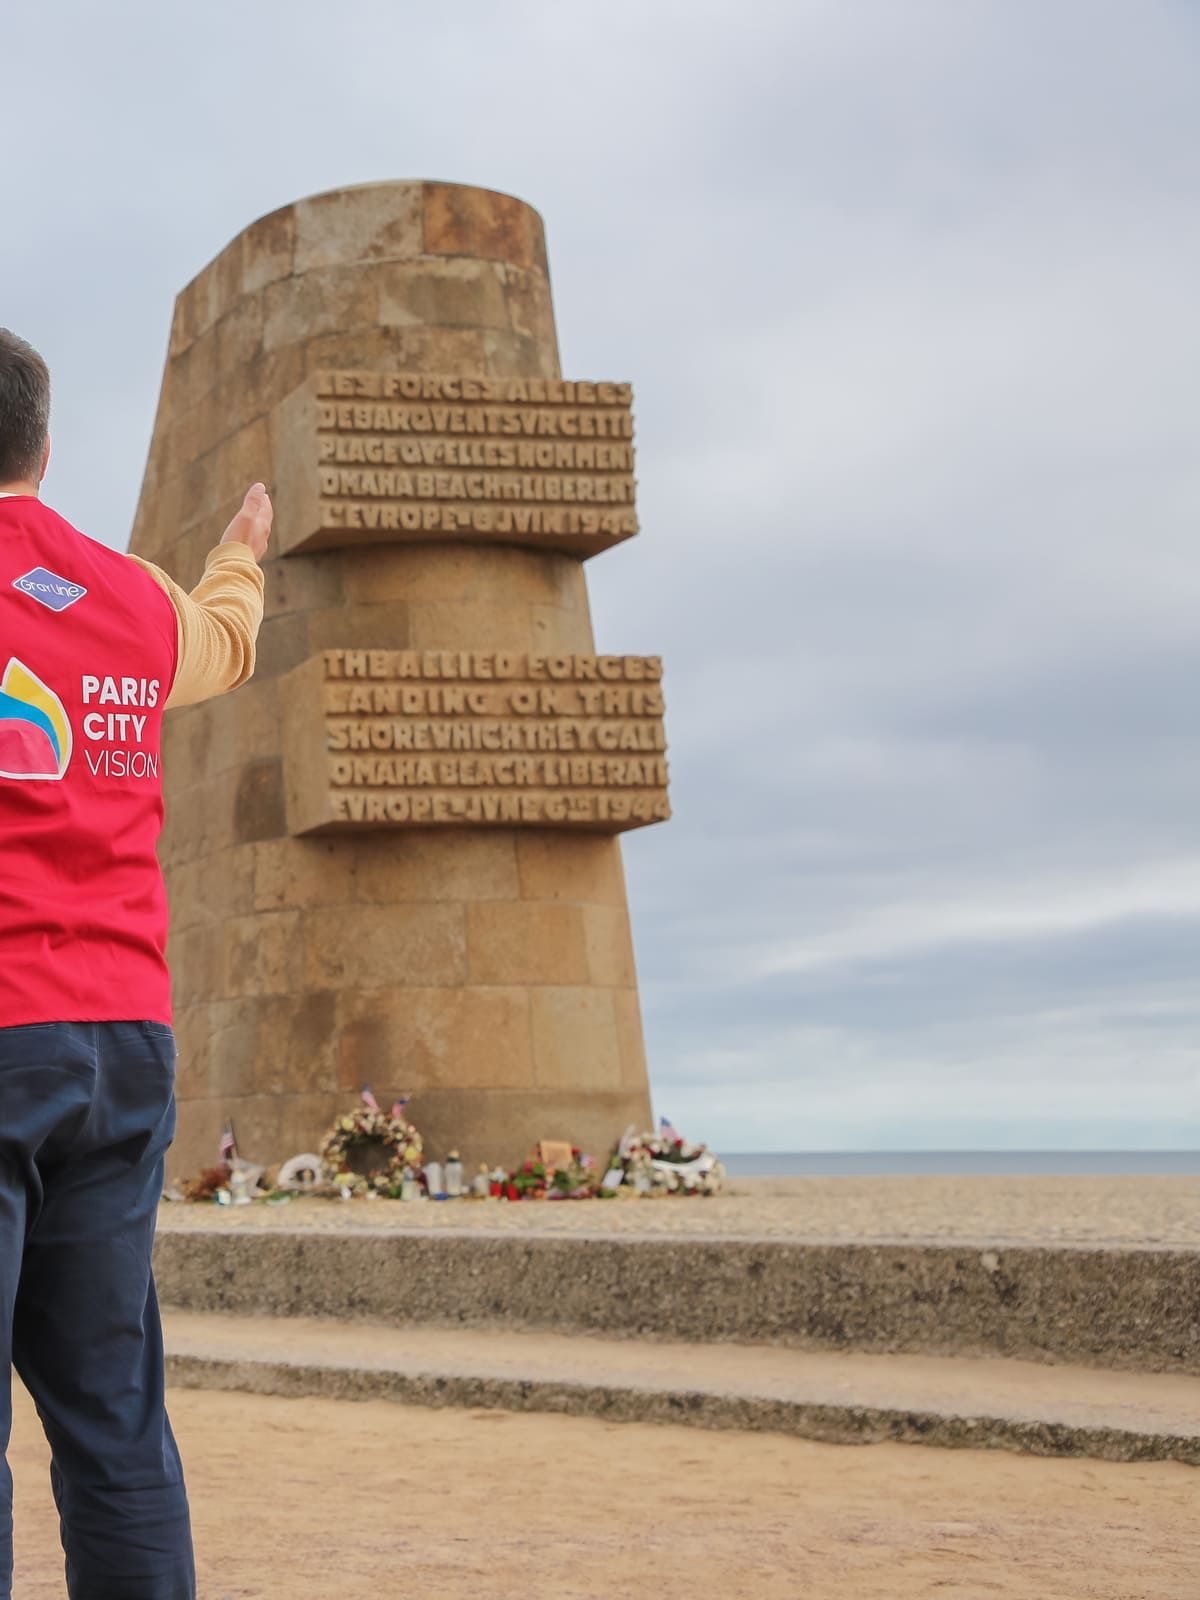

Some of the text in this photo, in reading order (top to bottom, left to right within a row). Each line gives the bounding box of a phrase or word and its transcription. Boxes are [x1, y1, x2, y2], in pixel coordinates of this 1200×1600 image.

[383, 375, 495, 400] FORCES
[506, 379, 633, 404] ALLIEES
[319, 437, 399, 464] PLAGE
[321, 470, 415, 497] OMAHA
[416, 472, 500, 499] BEACH
[324, 650, 661, 681] THE ALLIED FORCES
[82, 675, 160, 708] PARIS
[326, 685, 664, 716] LANDING ON THIS
[83, 713, 147, 742] CITY
[326, 719, 429, 750] SHORE
[520, 721, 594, 750] THEY
[596, 721, 667, 750] CALL
[84, 750, 158, 779] VISION
[329, 756, 437, 785] OMAHA
[438, 757, 536, 785] BEACH
[596, 795, 672, 821] 1944
